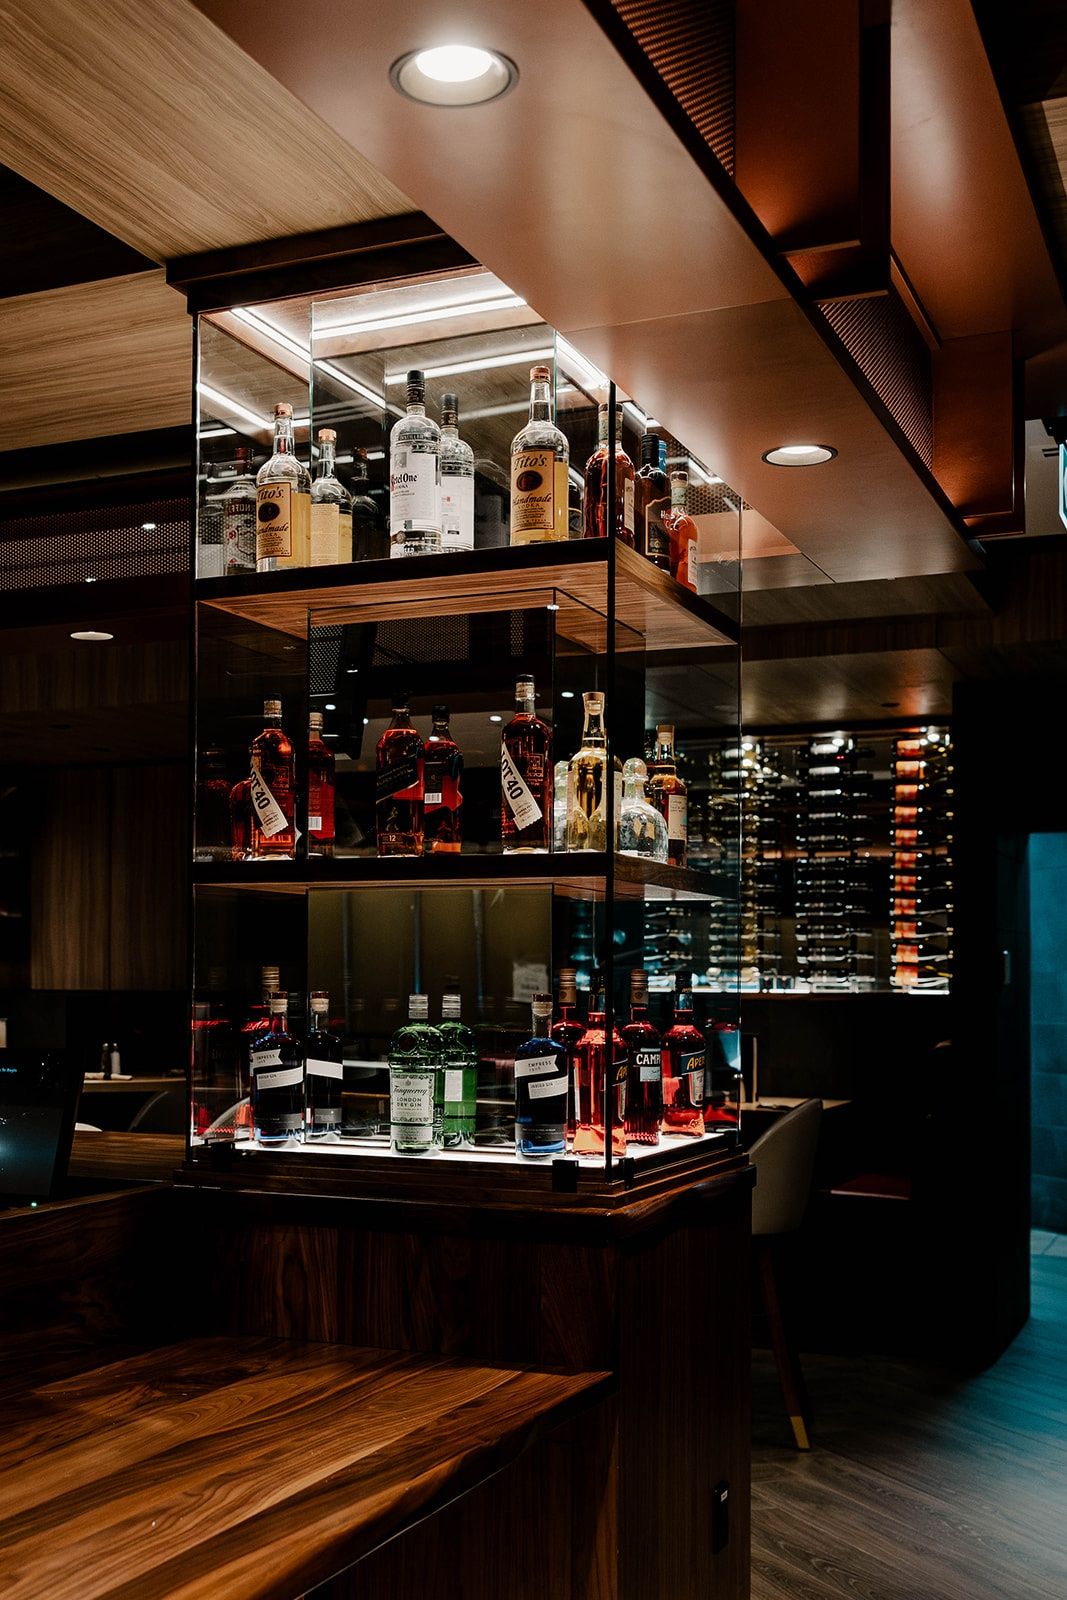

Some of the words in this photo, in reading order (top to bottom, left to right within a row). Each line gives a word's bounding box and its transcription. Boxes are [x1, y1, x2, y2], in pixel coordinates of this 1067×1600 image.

[506, 780, 524, 801] 40
[255, 791, 271, 810] 40
[389, 834, 397, 842] 12
[636, 1053, 661, 1065] CAMP
[686, 1056, 705, 1071] APER
[392, 1085, 428, 1096] Tanqueray
